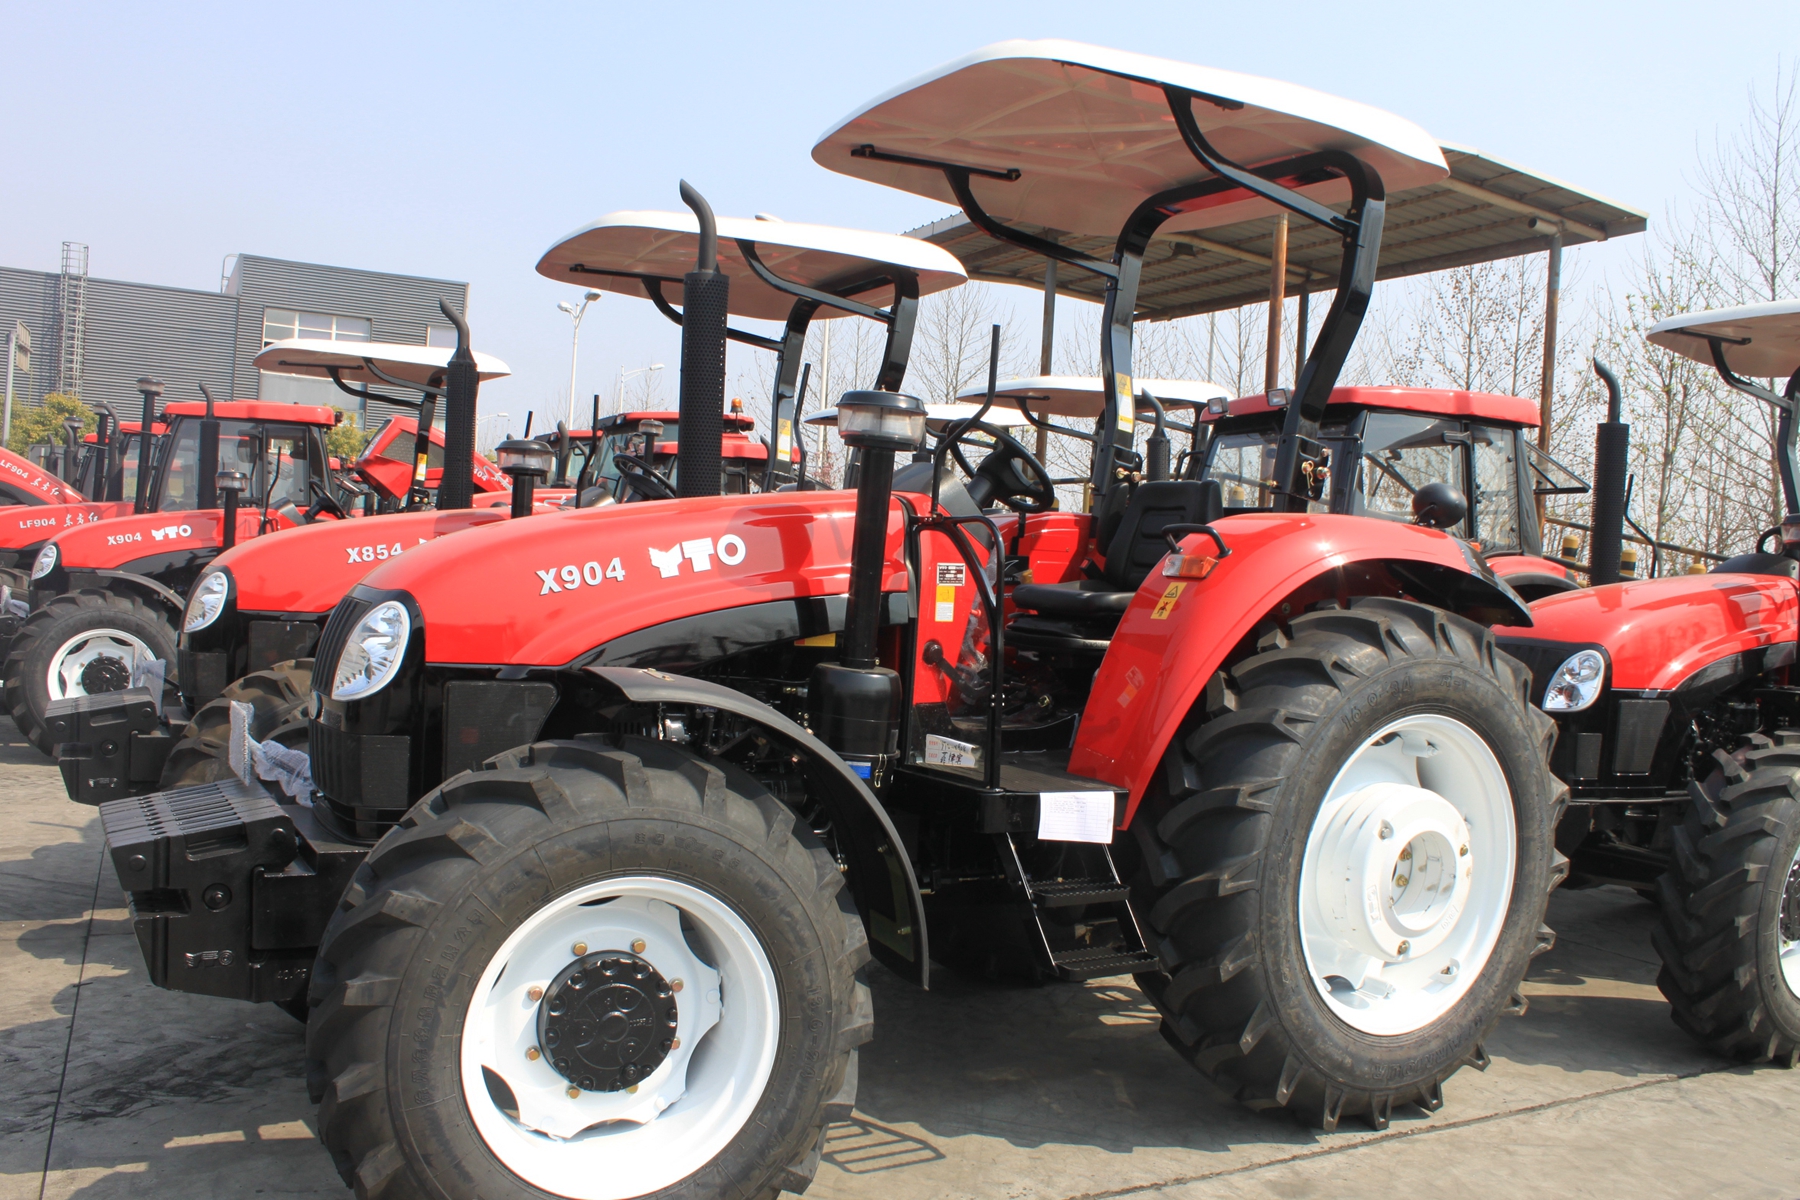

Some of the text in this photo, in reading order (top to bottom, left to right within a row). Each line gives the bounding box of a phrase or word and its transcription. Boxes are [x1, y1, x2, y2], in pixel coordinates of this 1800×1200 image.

[0, 459, 29, 479] LF904
[19, 517, 57, 529] LF904
[106, 524, 192, 546] X904 YTO
[345, 541, 405, 565] X854
[535, 533, 747, 596] X904 YTO
